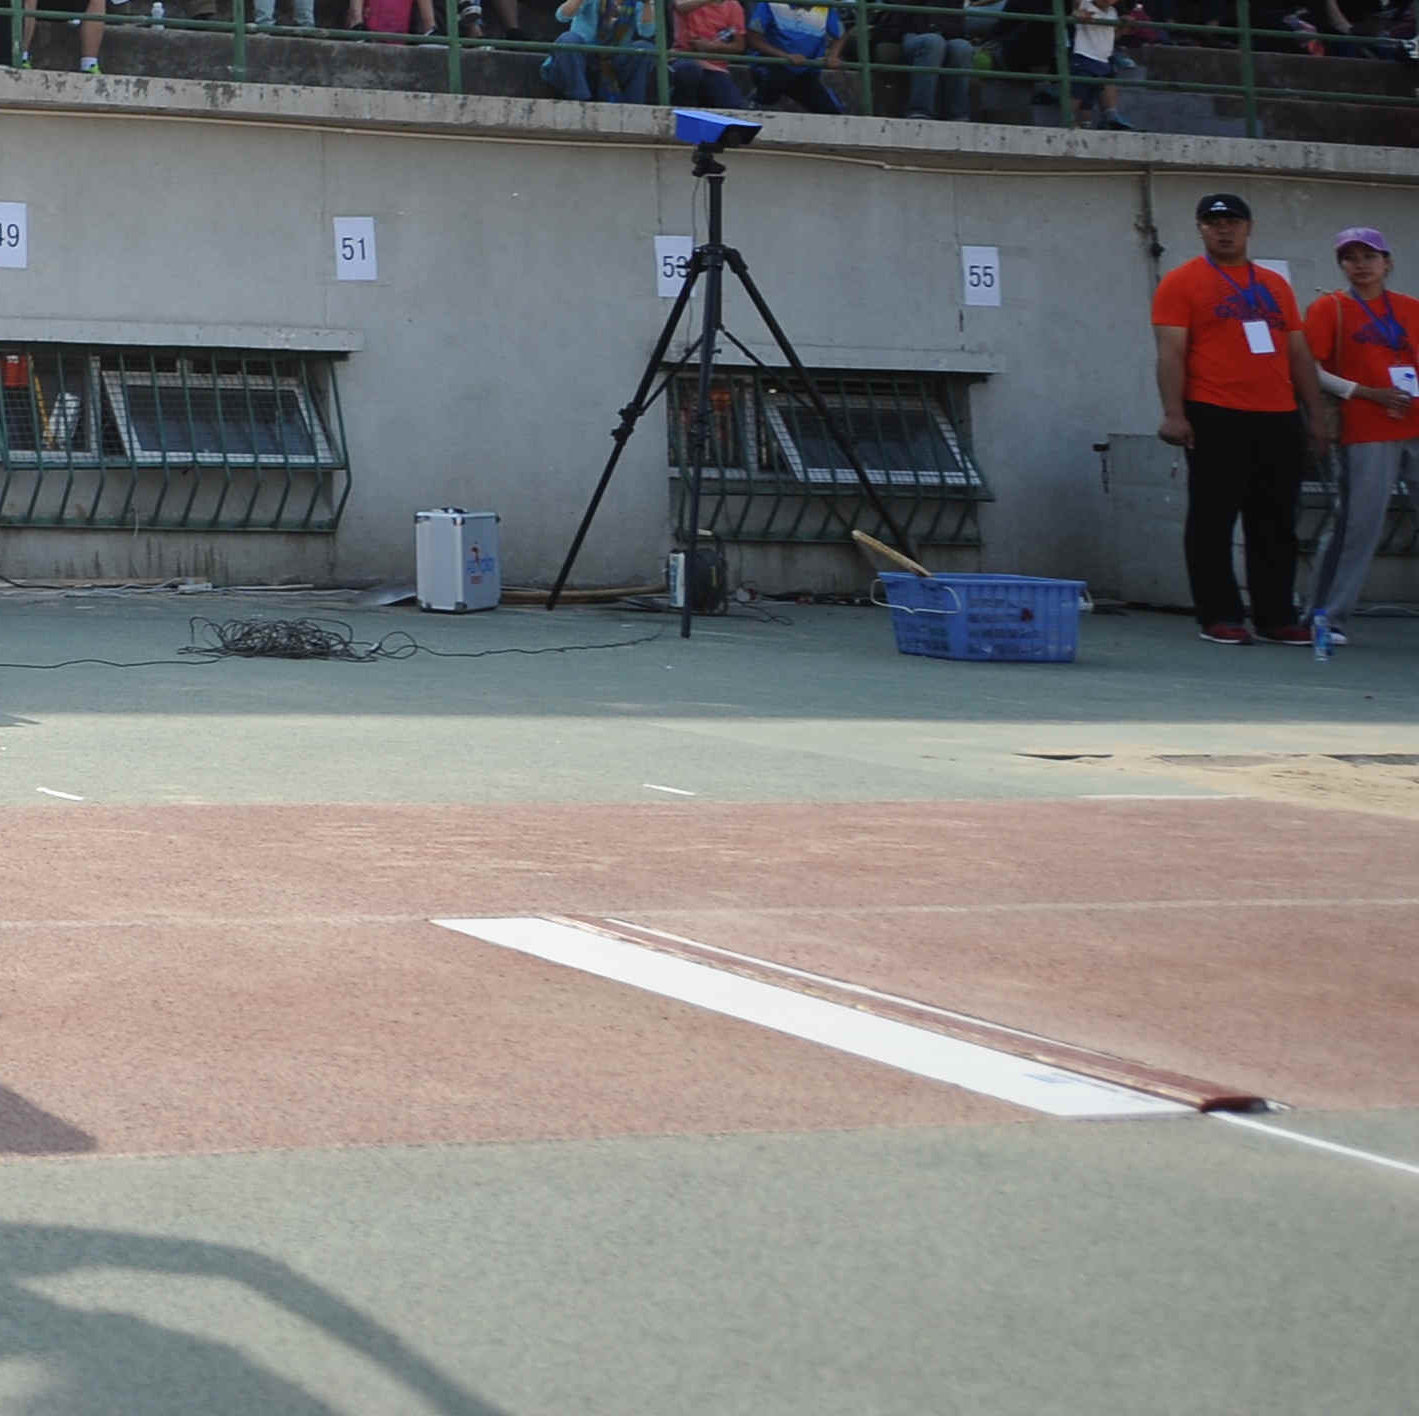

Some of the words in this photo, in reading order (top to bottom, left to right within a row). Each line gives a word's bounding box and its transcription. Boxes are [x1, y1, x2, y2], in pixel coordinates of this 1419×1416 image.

[341, 237, 366, 261] 51
[662, 255, 689, 278] 53
[969, 265, 995, 288] 55
